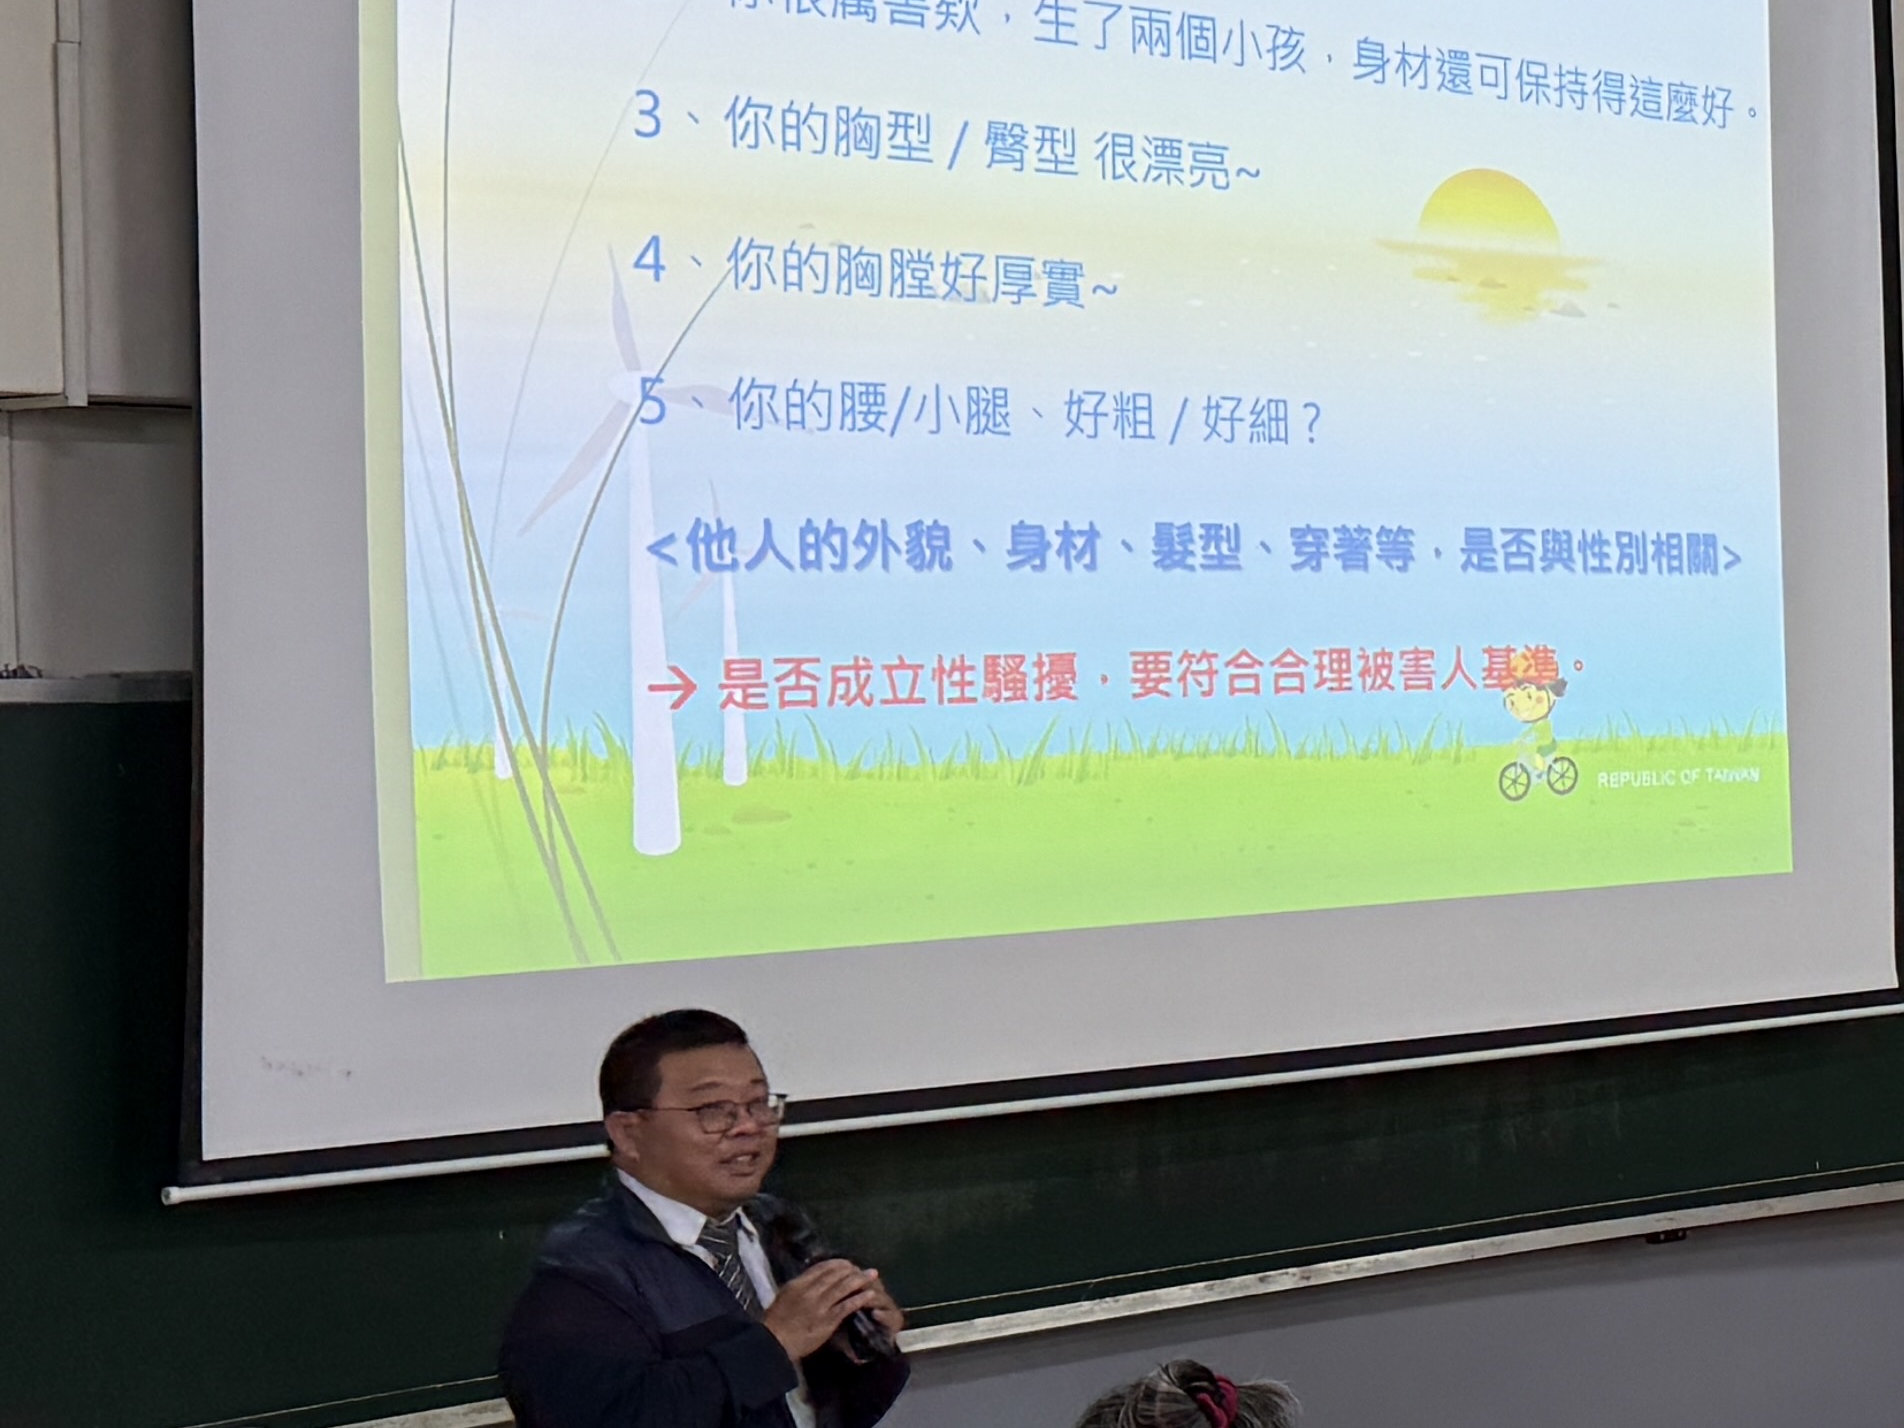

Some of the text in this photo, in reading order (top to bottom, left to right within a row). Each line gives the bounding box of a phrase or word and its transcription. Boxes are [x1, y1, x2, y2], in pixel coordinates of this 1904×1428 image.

[1598, 766, 1761, 788] REPUBLIC OF TAIWAN
